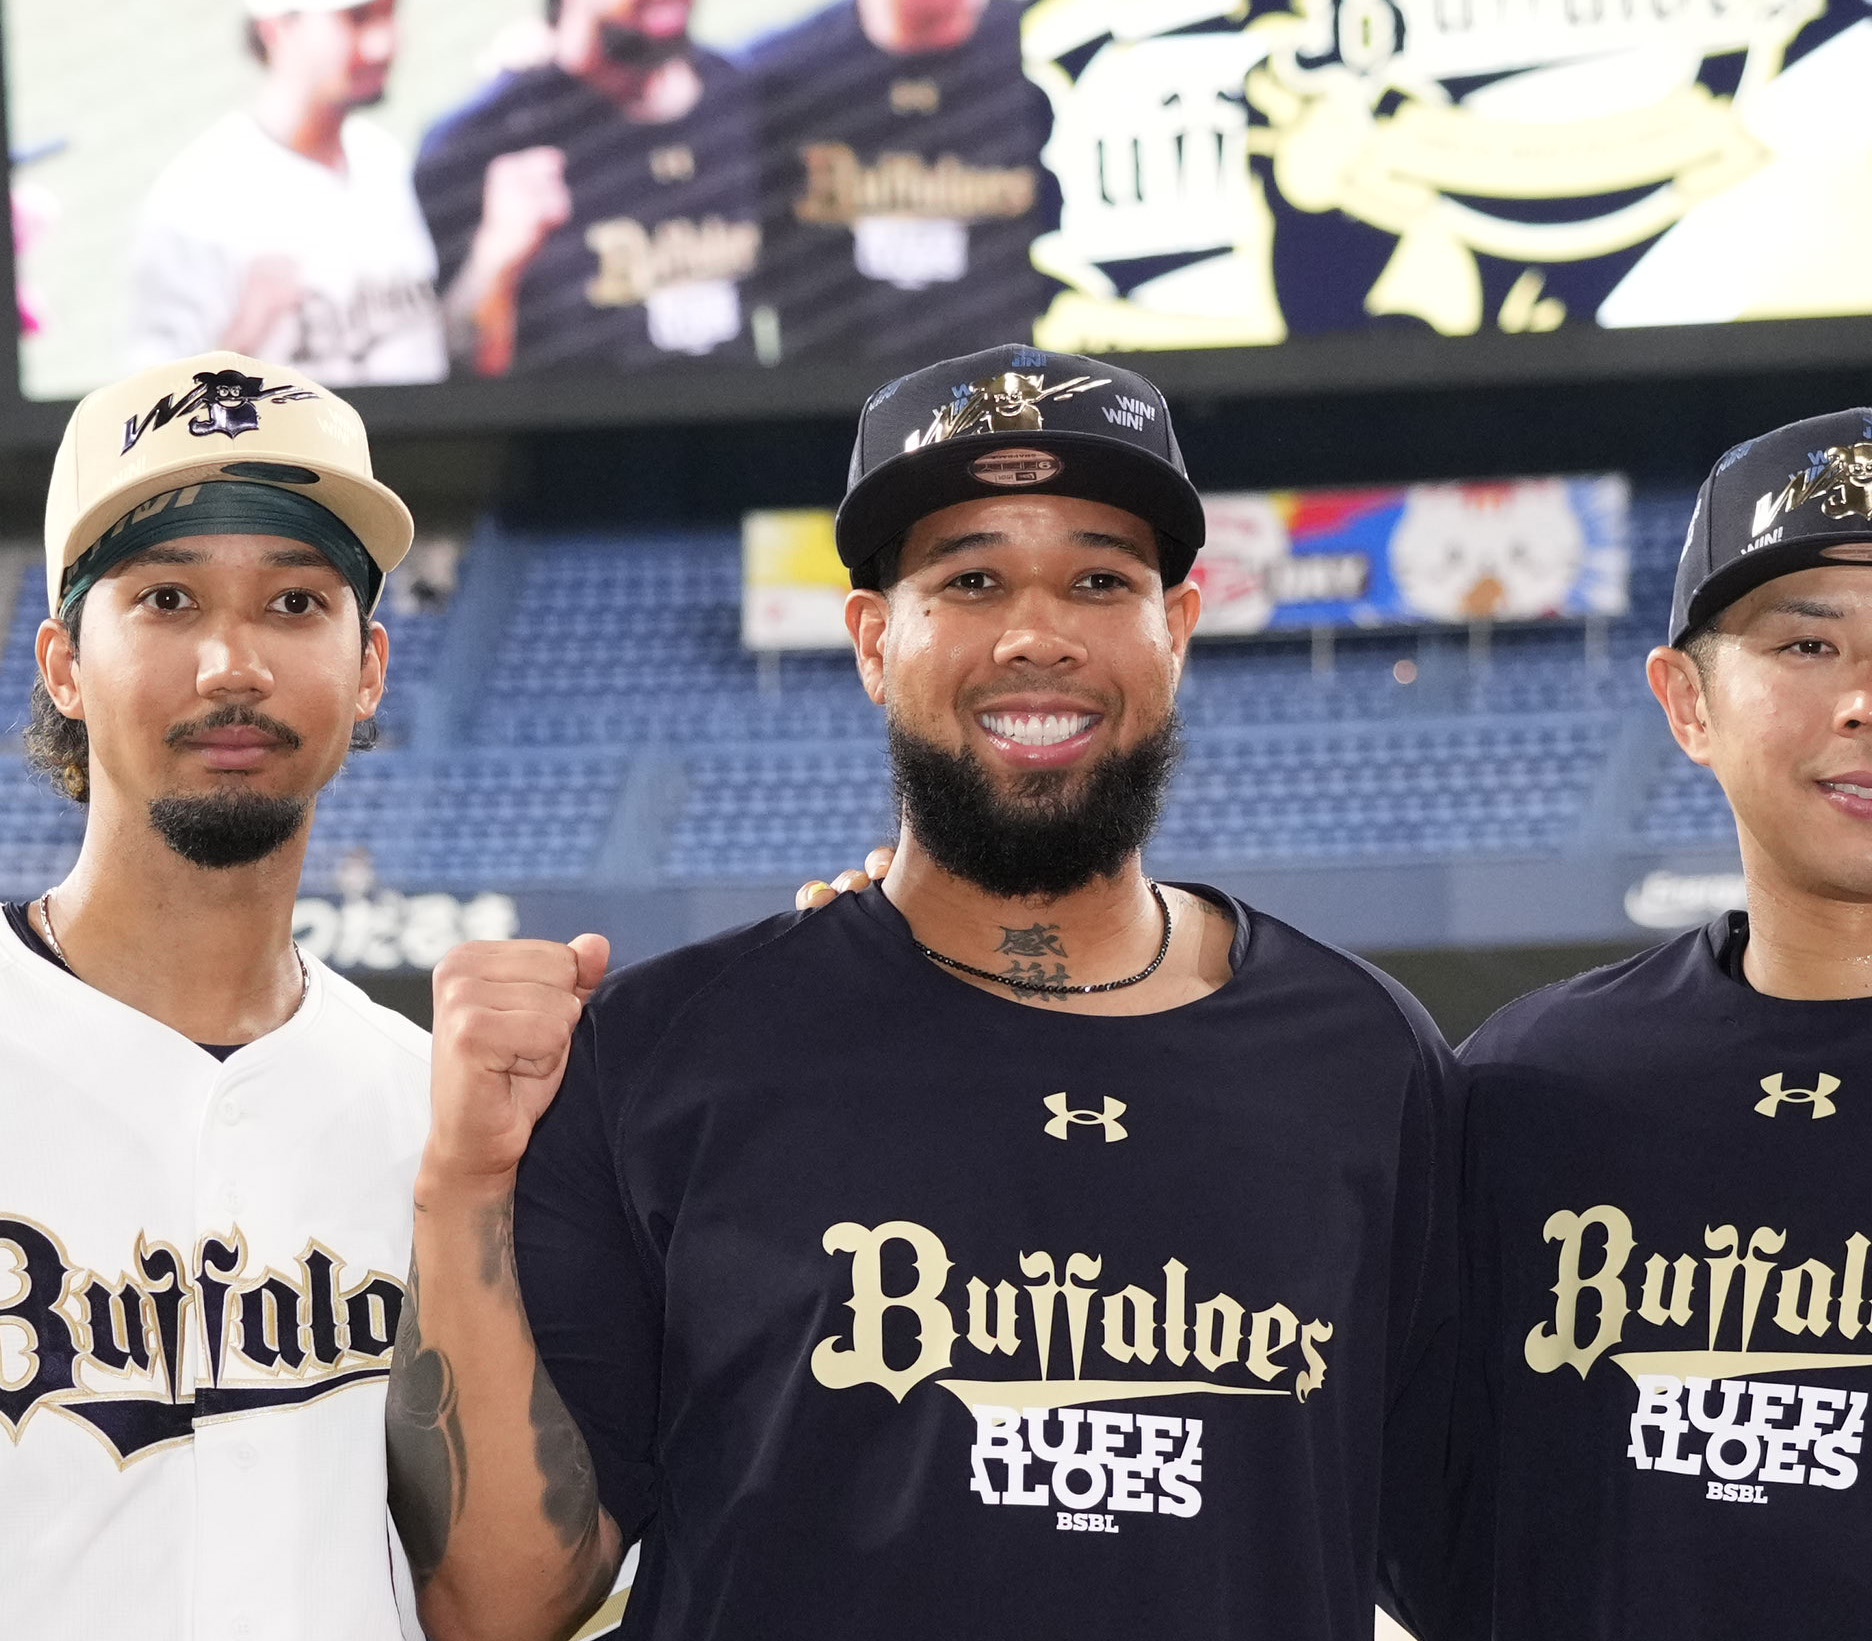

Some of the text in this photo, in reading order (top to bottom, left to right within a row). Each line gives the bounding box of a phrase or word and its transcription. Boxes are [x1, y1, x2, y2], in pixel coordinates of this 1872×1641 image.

[1101, 406, 1144, 432] WIN!
[1114, 393, 1156, 422] WIN!
[811, 1220, 1334, 1404] Buffaloes
[1706, 1481, 1768, 1504] BSBL
[1056, 1512, 1119, 1534] BSBL
